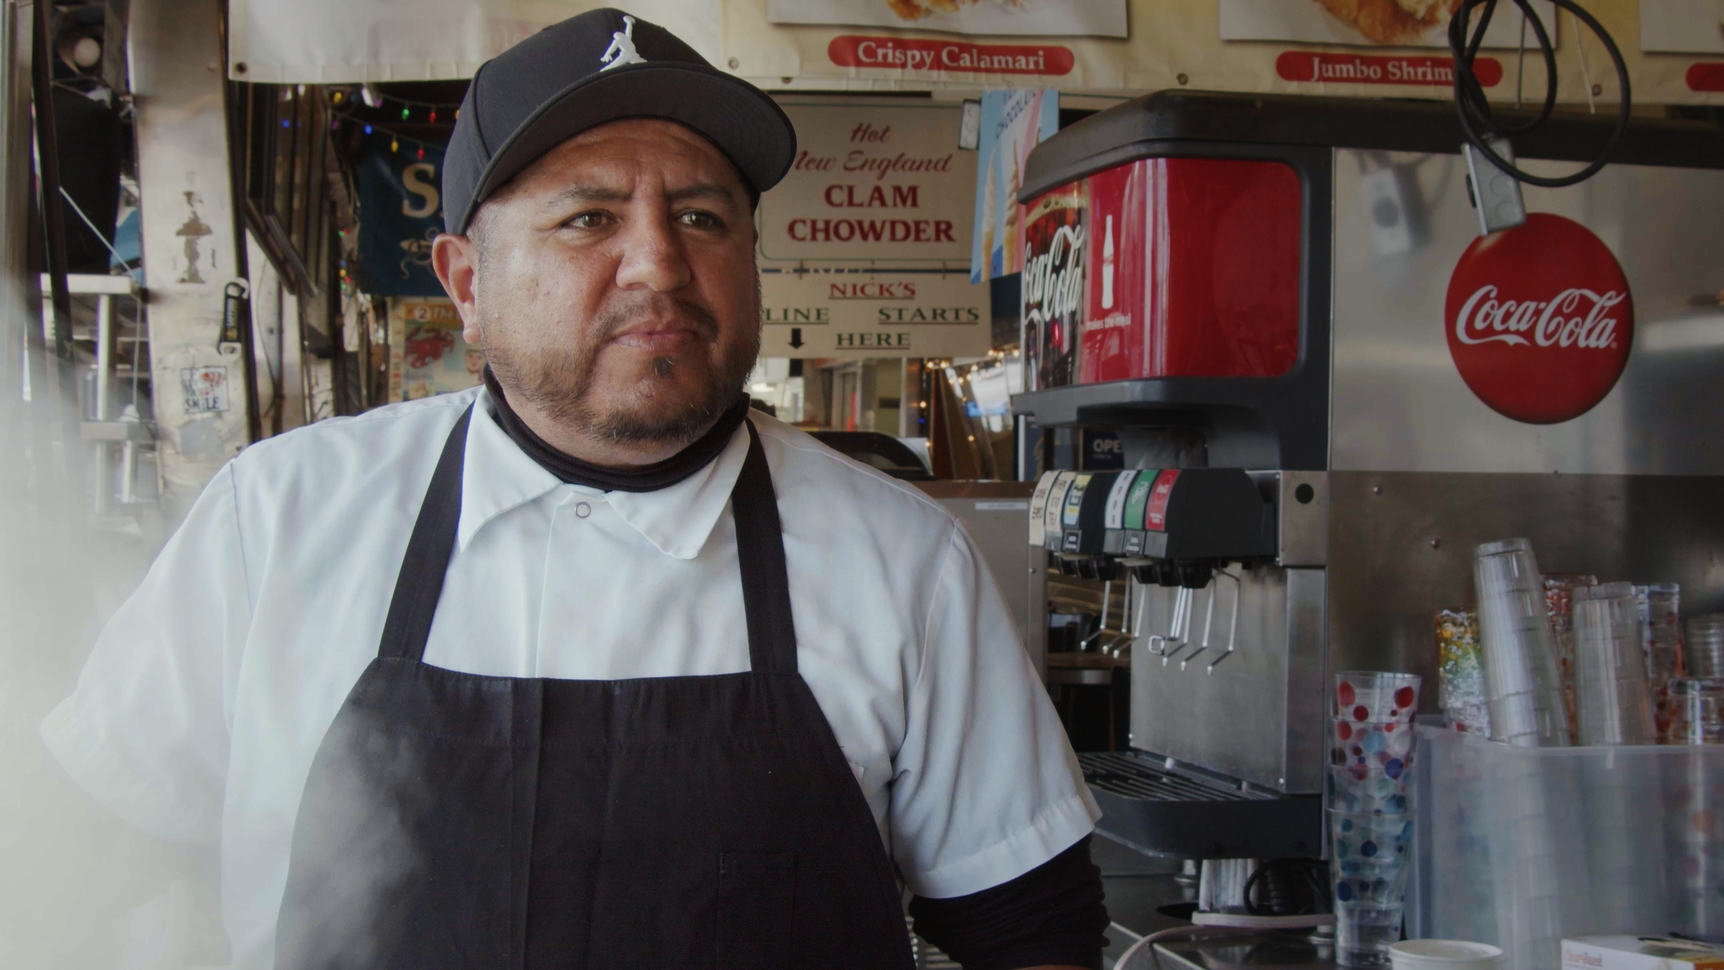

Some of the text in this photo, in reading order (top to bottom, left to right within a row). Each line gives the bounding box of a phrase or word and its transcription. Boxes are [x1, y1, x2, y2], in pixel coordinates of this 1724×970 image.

[857, 41, 1045, 70] Crispy Calamari
[1311, 57, 1453, 81] Jumbo Shrim
[850, 122, 891, 143] Hot
[843, 149, 954, 181] England
[824, 184, 921, 209] CLAM
[787, 218, 957, 243] CHOWDER
[828, 281, 916, 298] NICK'S
[764, 307, 980, 322] LINE STARTS
[1456, 284, 1627, 349] Coca-Cola
[835, 333, 912, 347] HERE
[1092, 438, 1124, 454] OPE
